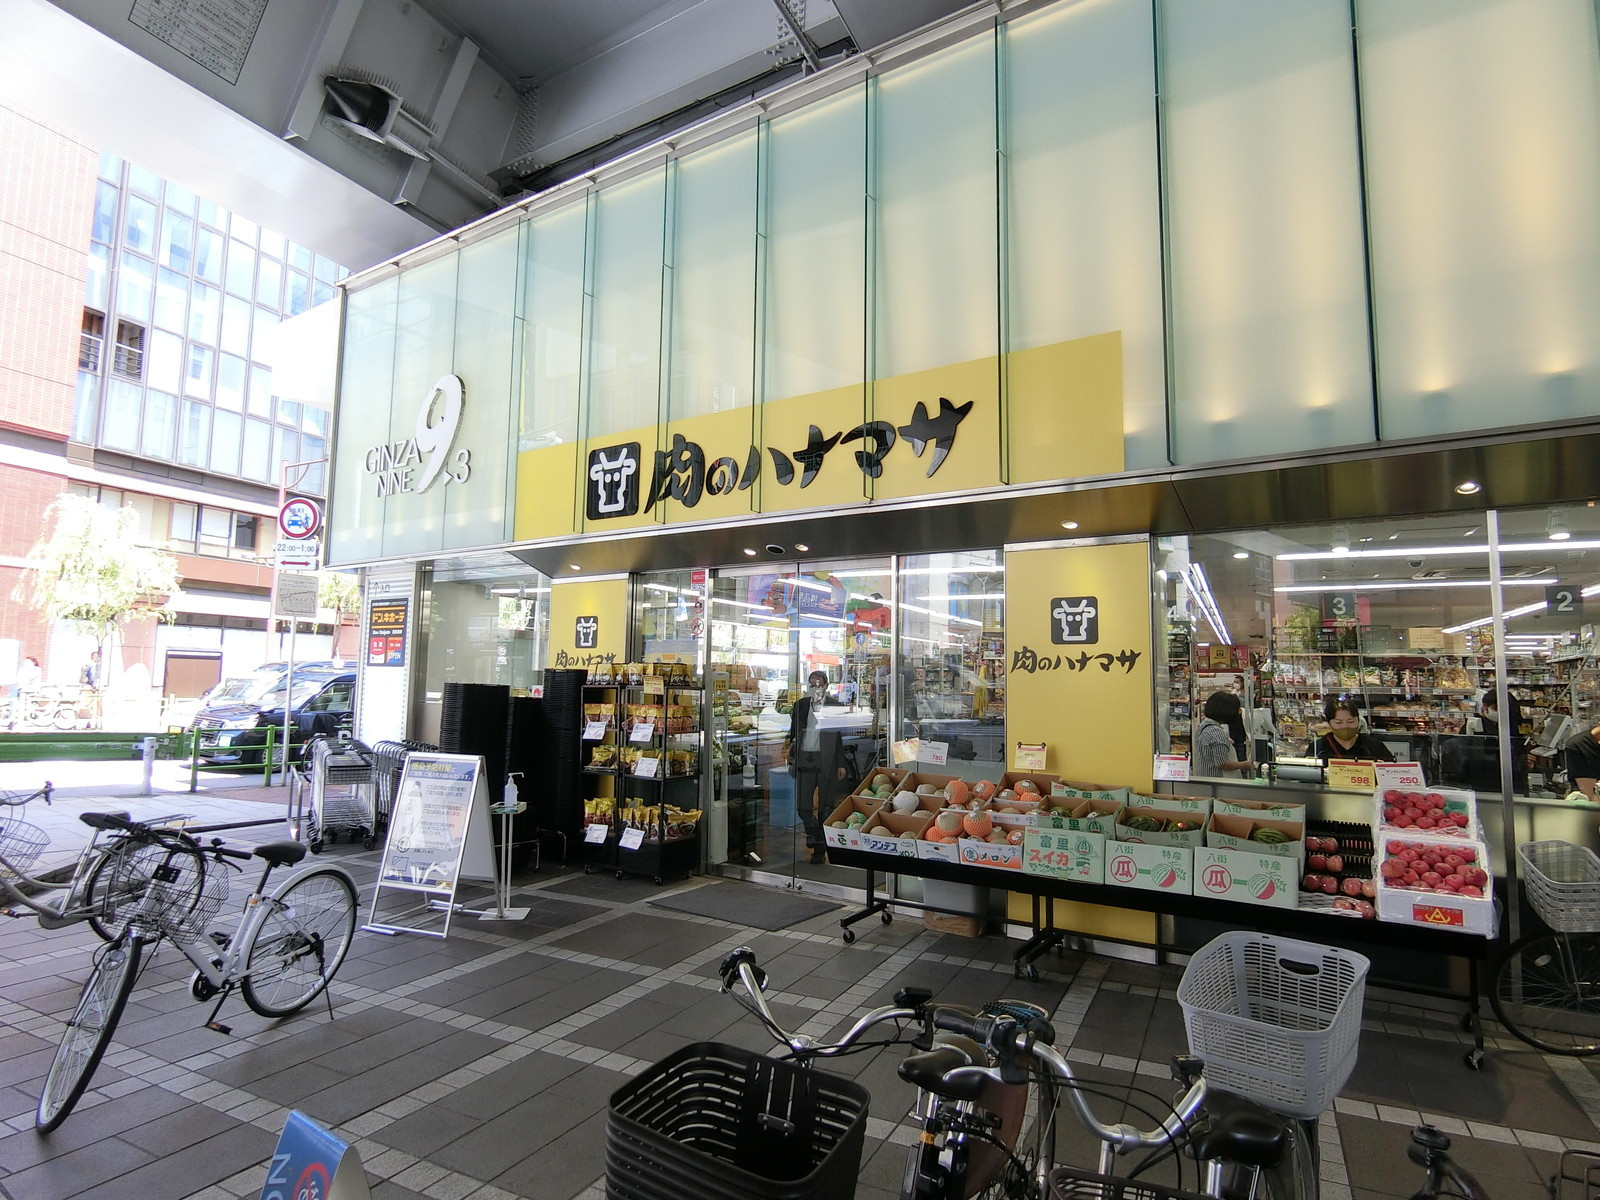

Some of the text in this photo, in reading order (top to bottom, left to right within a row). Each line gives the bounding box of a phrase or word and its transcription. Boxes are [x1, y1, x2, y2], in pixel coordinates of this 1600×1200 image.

[416, 373, 466, 494] 9
[365, 437, 422, 475] GINZA
[644, 397, 973, 515] 肉のハナマサ
[454, 448, 471, 484] 3
[376, 468, 414, 497] NINE
[1332, 597, 1346, 615] 3
[1556, 591, 1574, 612] 2
[1010, 646, 1142, 674] 肉のハナマサ
[1350, 776, 1370, 784] 598
[1400, 776, 1419, 784] 250
[869, 840, 898, 853] アンデス
[1040, 835, 1069, 851] 富里
[1115, 844, 1134, 855] 八街
[980, 852, 1011, 864] メロン
[1029, 849, 1069, 866] スイカ
[1162, 850, 1182, 860] 特産
[1207, 853, 1228, 864] 八街
[1114, 861, 1133, 878] 瓜
[1259, 860, 1281, 870] 特産
[1206, 870, 1227, 889] 瓜
